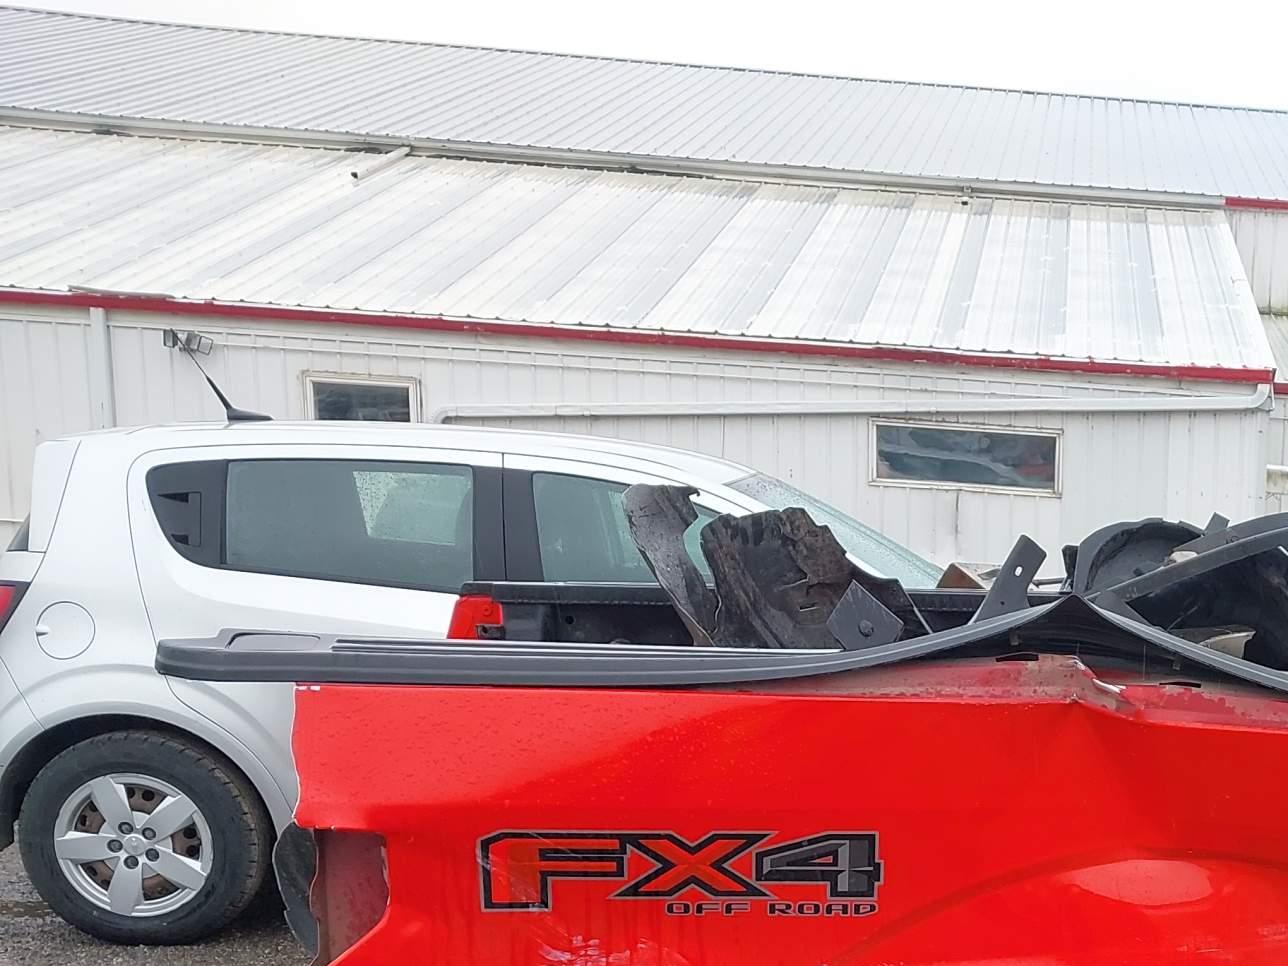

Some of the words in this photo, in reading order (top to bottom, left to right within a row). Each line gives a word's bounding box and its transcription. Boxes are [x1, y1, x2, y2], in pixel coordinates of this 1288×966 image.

[477, 829, 884, 912] FX4
[665, 901, 751, 916] OFF
[767, 901, 879, 917] ROAD
